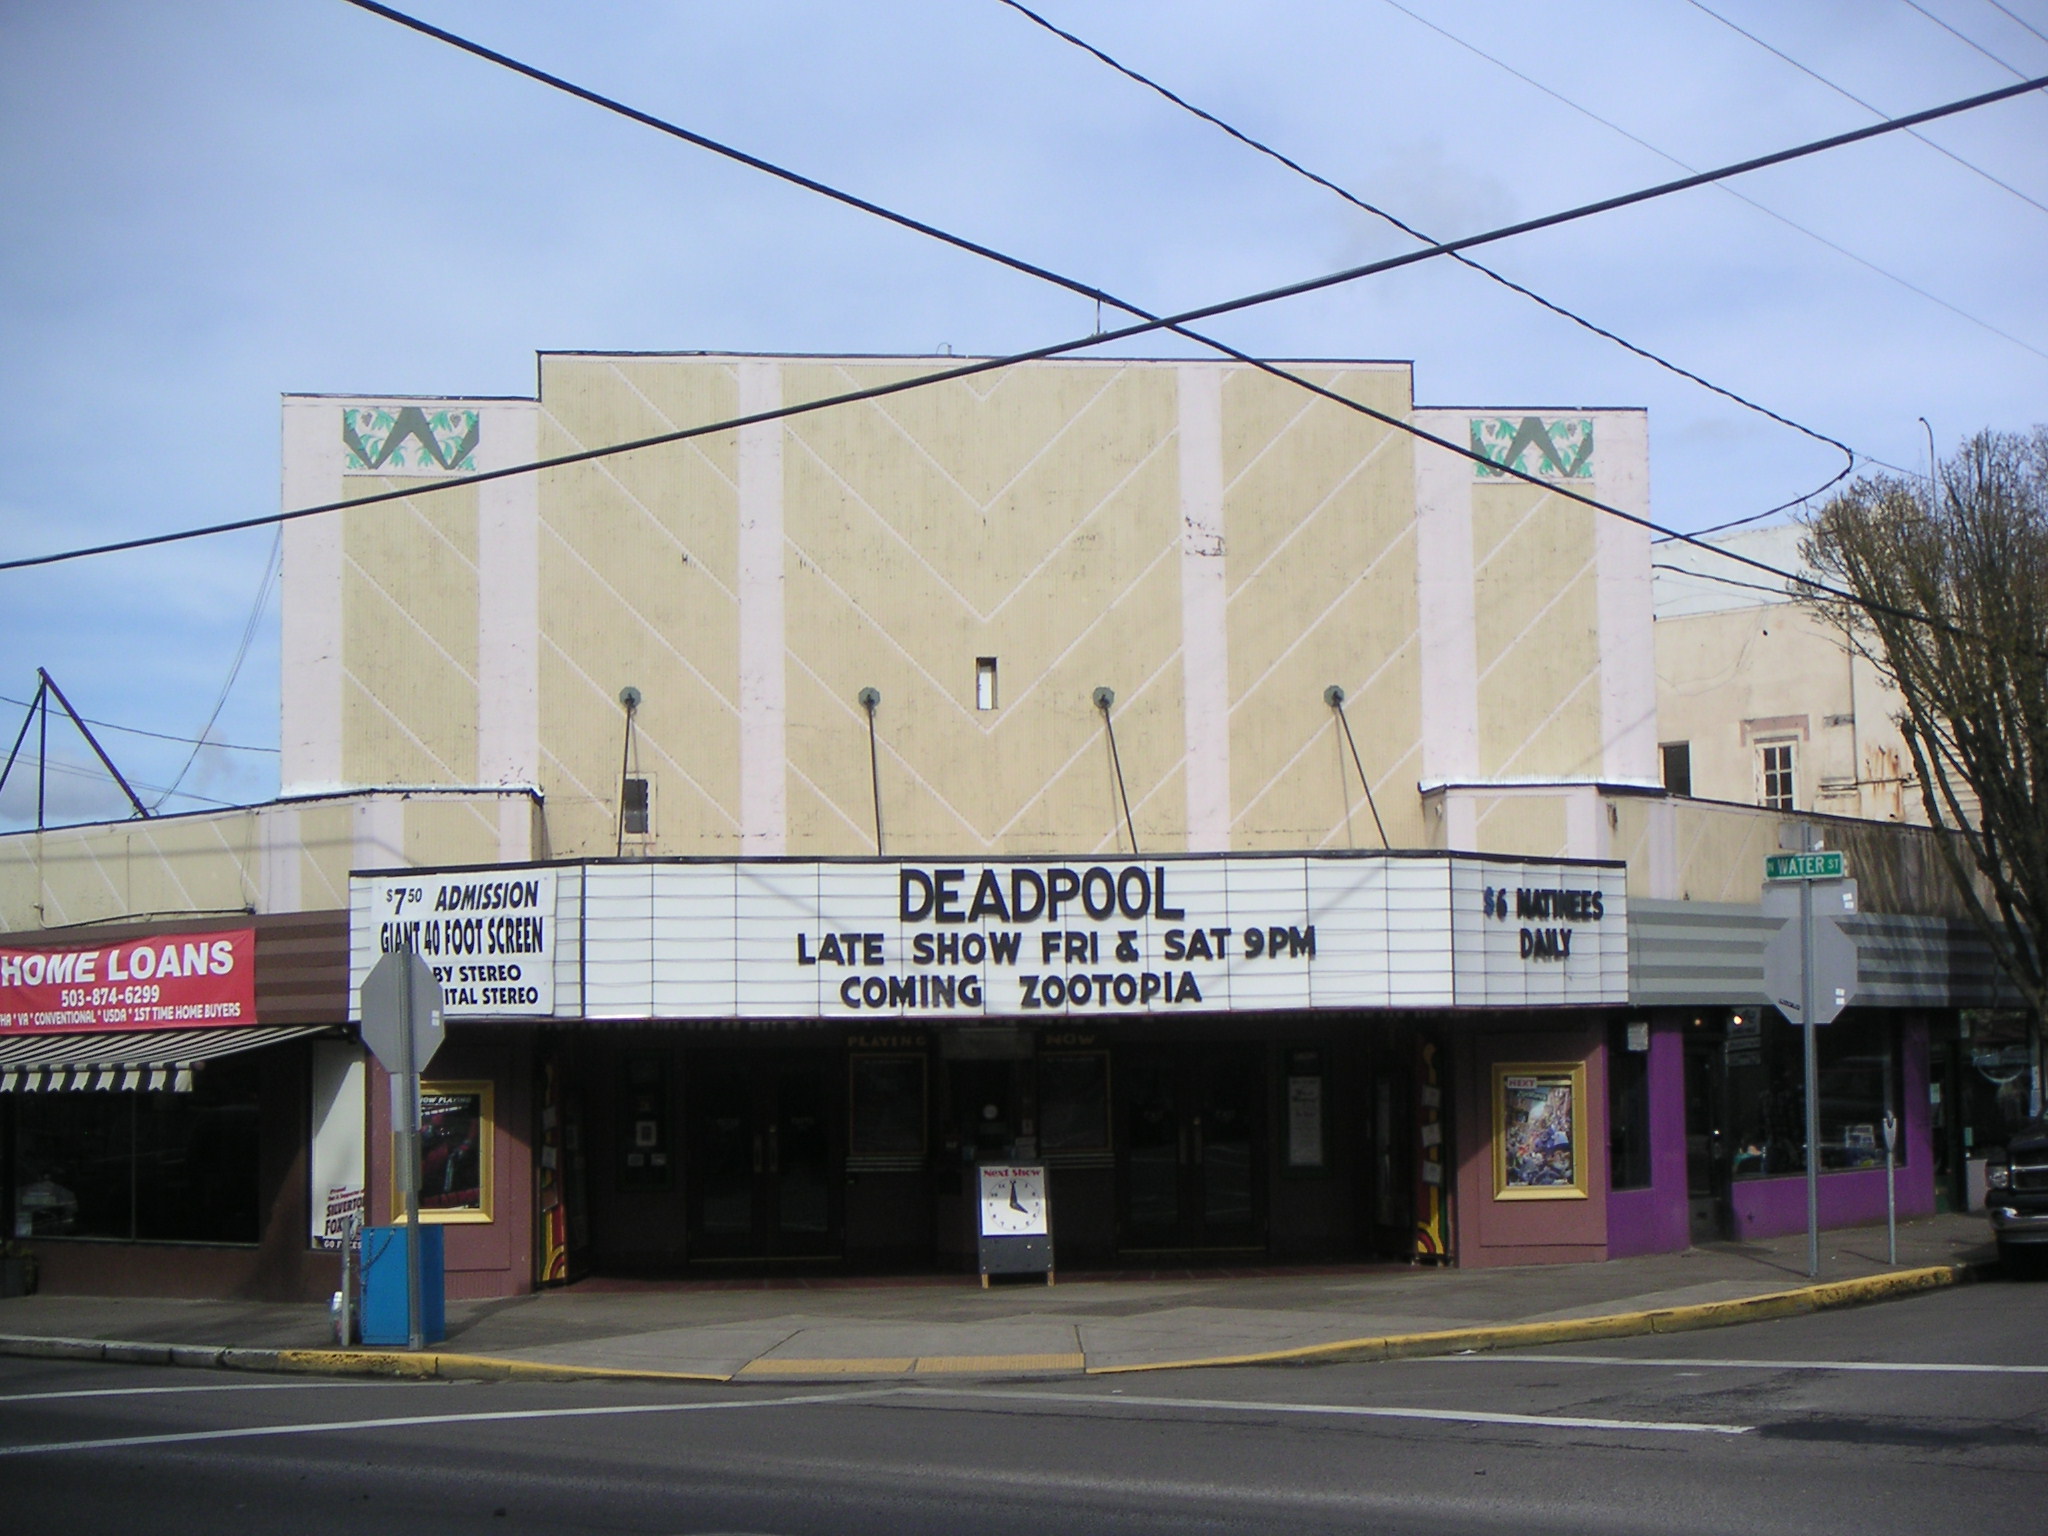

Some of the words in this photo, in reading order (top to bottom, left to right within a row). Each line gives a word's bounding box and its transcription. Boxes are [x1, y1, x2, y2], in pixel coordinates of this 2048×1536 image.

[1778, 856, 1825, 875] WATER
[1827, 858, 1840, 870] ST
[434, 880, 539, 912] ADMISSION
[899, 866, 1185, 923] DEADPOOL
[1516, 887, 1604, 921] MATINEES
[380, 921, 421, 955] GIANT
[424, 919, 441, 955] 40
[444, 918, 483, 955] FOOT
[487, 916, 544, 955] SCREEN
[797, 932, 884, 966] LATE
[912, 930, 1021, 966] SHOW
[1041, 930, 1098, 964] FRI
[1115, 930, 1139, 962] &
[1164, 927, 1232, 962] SAT
[1519, 928, 1573, 962] DAILY
[1, 951, 100, 988] HOME
[107, 940, 235, 982] LOANS
[458, 964, 522, 983] STEREO
[61, 984, 160, 1008] 503-874-6299
[444, 989, 478, 1006] ITAL
[482, 986, 539, 1006] STEREO
[840, 974, 983, 1009] COMING
[1019, 971, 1204, 1009] ZOOTOPIA
[17, 1012, 29, 1026] VA
[34, 1009, 97, 1026] CONVENTIONAL
[102, 1008, 127, 1023] USDA
[134, 1006, 151, 1022] 1ST
[152, 1005, 174, 1020] TIME
[175, 1003, 203, 1020] HOME
[204, 1002, 241, 1019] BUYERS
[847, 1035, 927, 1048] PLAYING
[1045, 1033, 1096, 1046] NOW
[983, 1169, 1009, 1177] Next
[1012, 1168, 1041, 1177] Show
